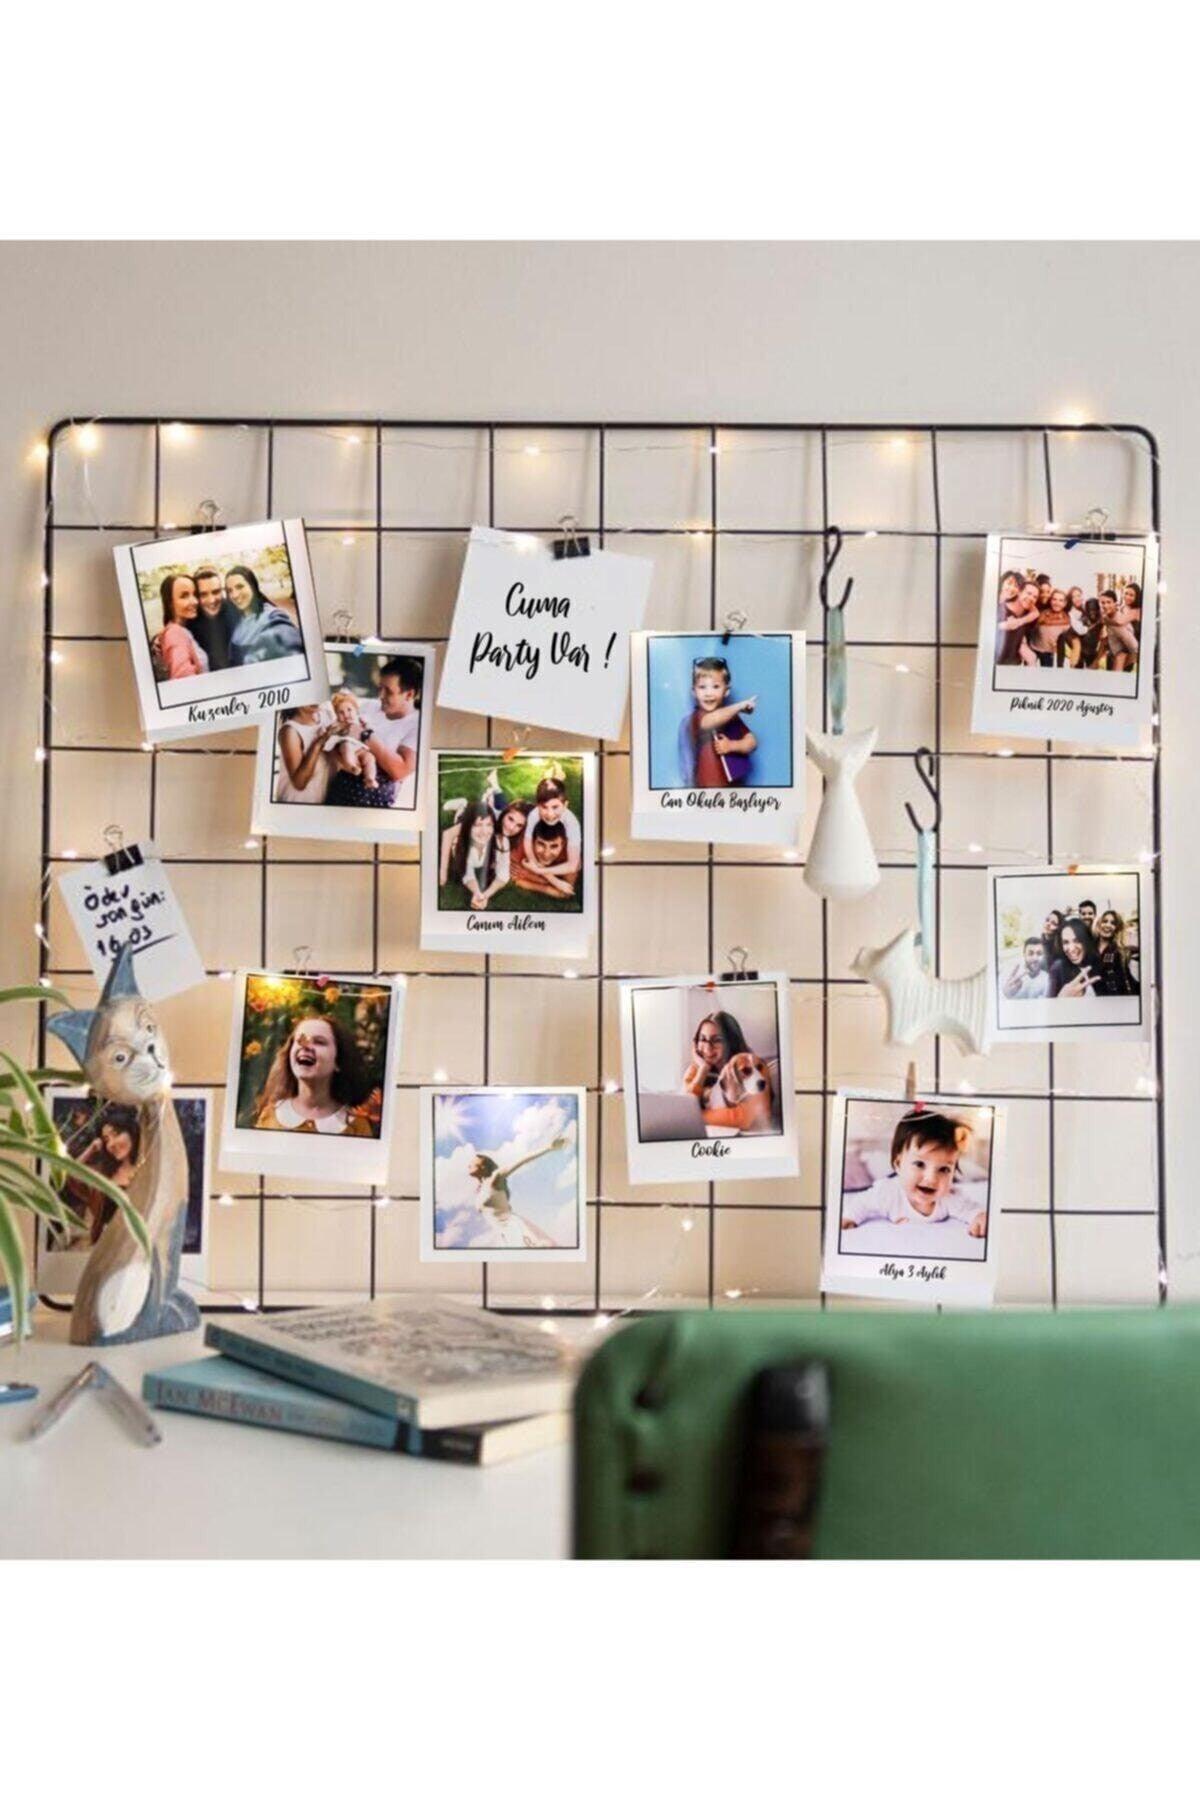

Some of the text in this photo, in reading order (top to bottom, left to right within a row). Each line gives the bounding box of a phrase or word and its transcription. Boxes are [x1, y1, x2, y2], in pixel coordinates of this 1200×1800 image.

[505, 581, 571, 619] Cuma
[469, 631, 617, 680] Party Var !
[188, 687, 291, 722] Kuzenler 2010
[1010, 696, 1045, 712] Piknik
[1046, 698, 1074, 712] 2020
[660, 791, 683, 809] Can
[686, 790, 726, 809] Okula
[507, 914, 546, 932] Ailem
[97, 924, 153, 957] 1603
[691, 1140, 731, 1158] Cookie
[879, 1263, 905, 1281] Alya
[907, 1264, 915, 1278] 3
